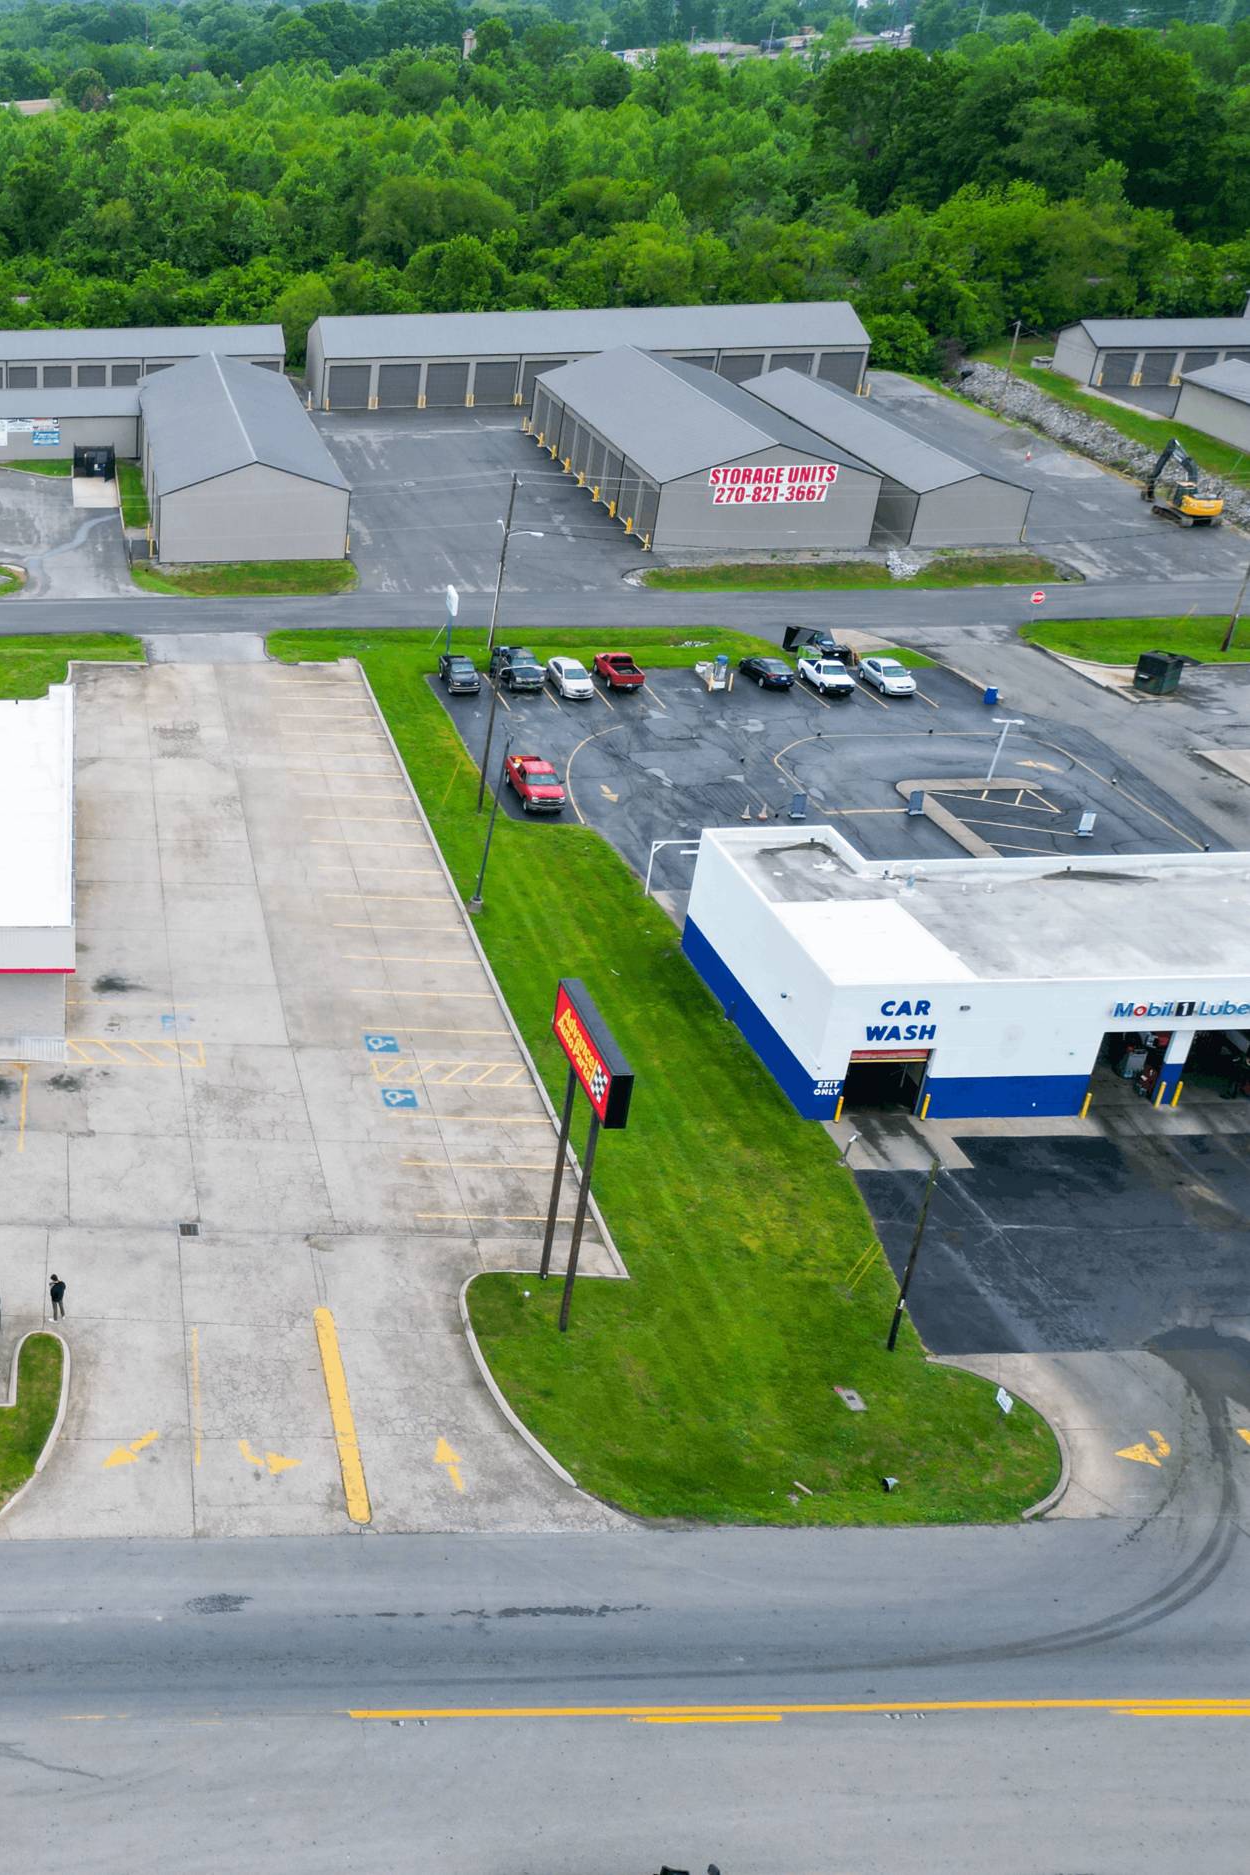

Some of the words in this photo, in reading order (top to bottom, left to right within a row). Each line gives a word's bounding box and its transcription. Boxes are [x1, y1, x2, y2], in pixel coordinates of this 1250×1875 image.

[710, 468, 784, 485] STORAGE
[787, 465, 837, 483] UNITS
[715, 485, 826, 503] 270-821-3667
[880, 1000, 931, 1017] CAR
[1113, 1002, 1174, 1017] Mobil
[1198, 1001, 1250, 1016] Lube
[562, 1008, 595, 1070] Advance
[866, 1025, 937, 1041] WASH
[557, 1018, 574, 1049] Auto
[572, 1046, 591, 1081] Parts
